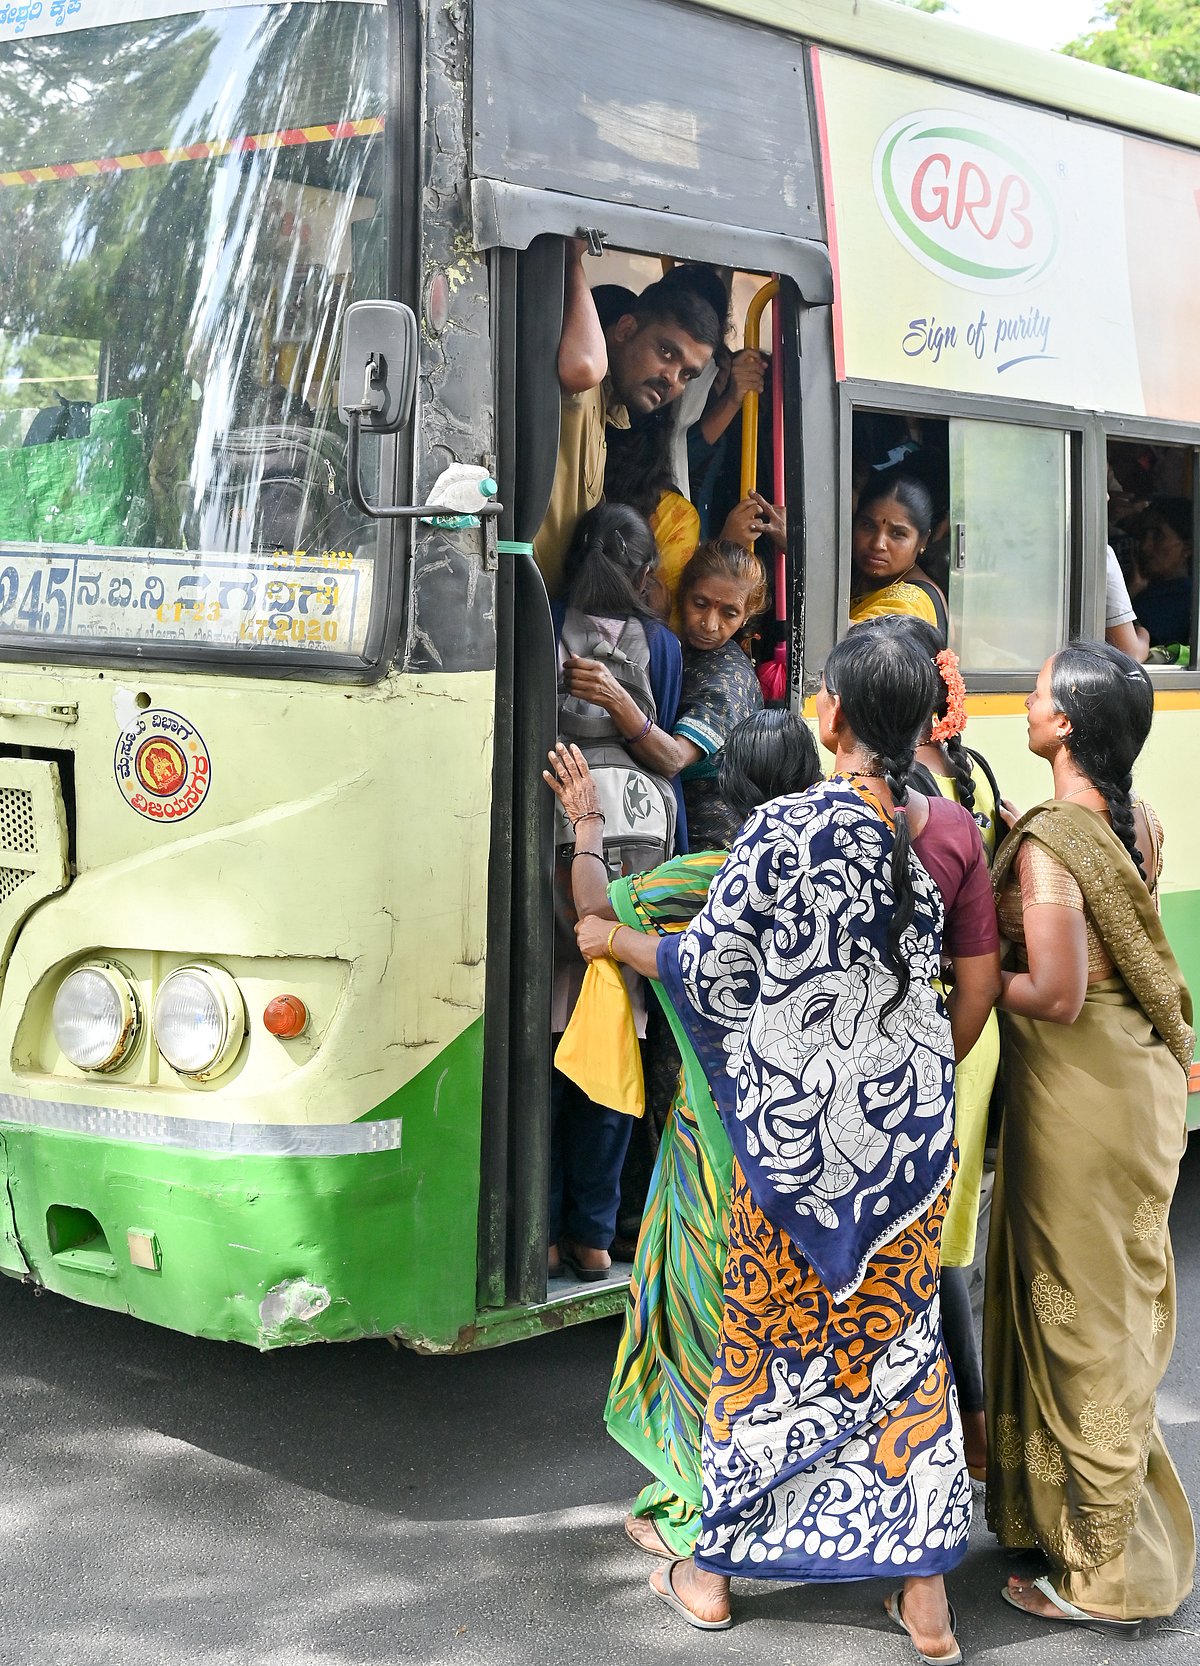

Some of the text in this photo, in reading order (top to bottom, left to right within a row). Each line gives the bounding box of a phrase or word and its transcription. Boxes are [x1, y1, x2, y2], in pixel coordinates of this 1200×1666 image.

[911, 153, 1034, 249] GRB
[902, 306, 1051, 363] Sign of purity
[152, 714, 194, 741] ವಿಭಾಗ
[130, 755, 209, 819] ವಿಜಯನಗರ
